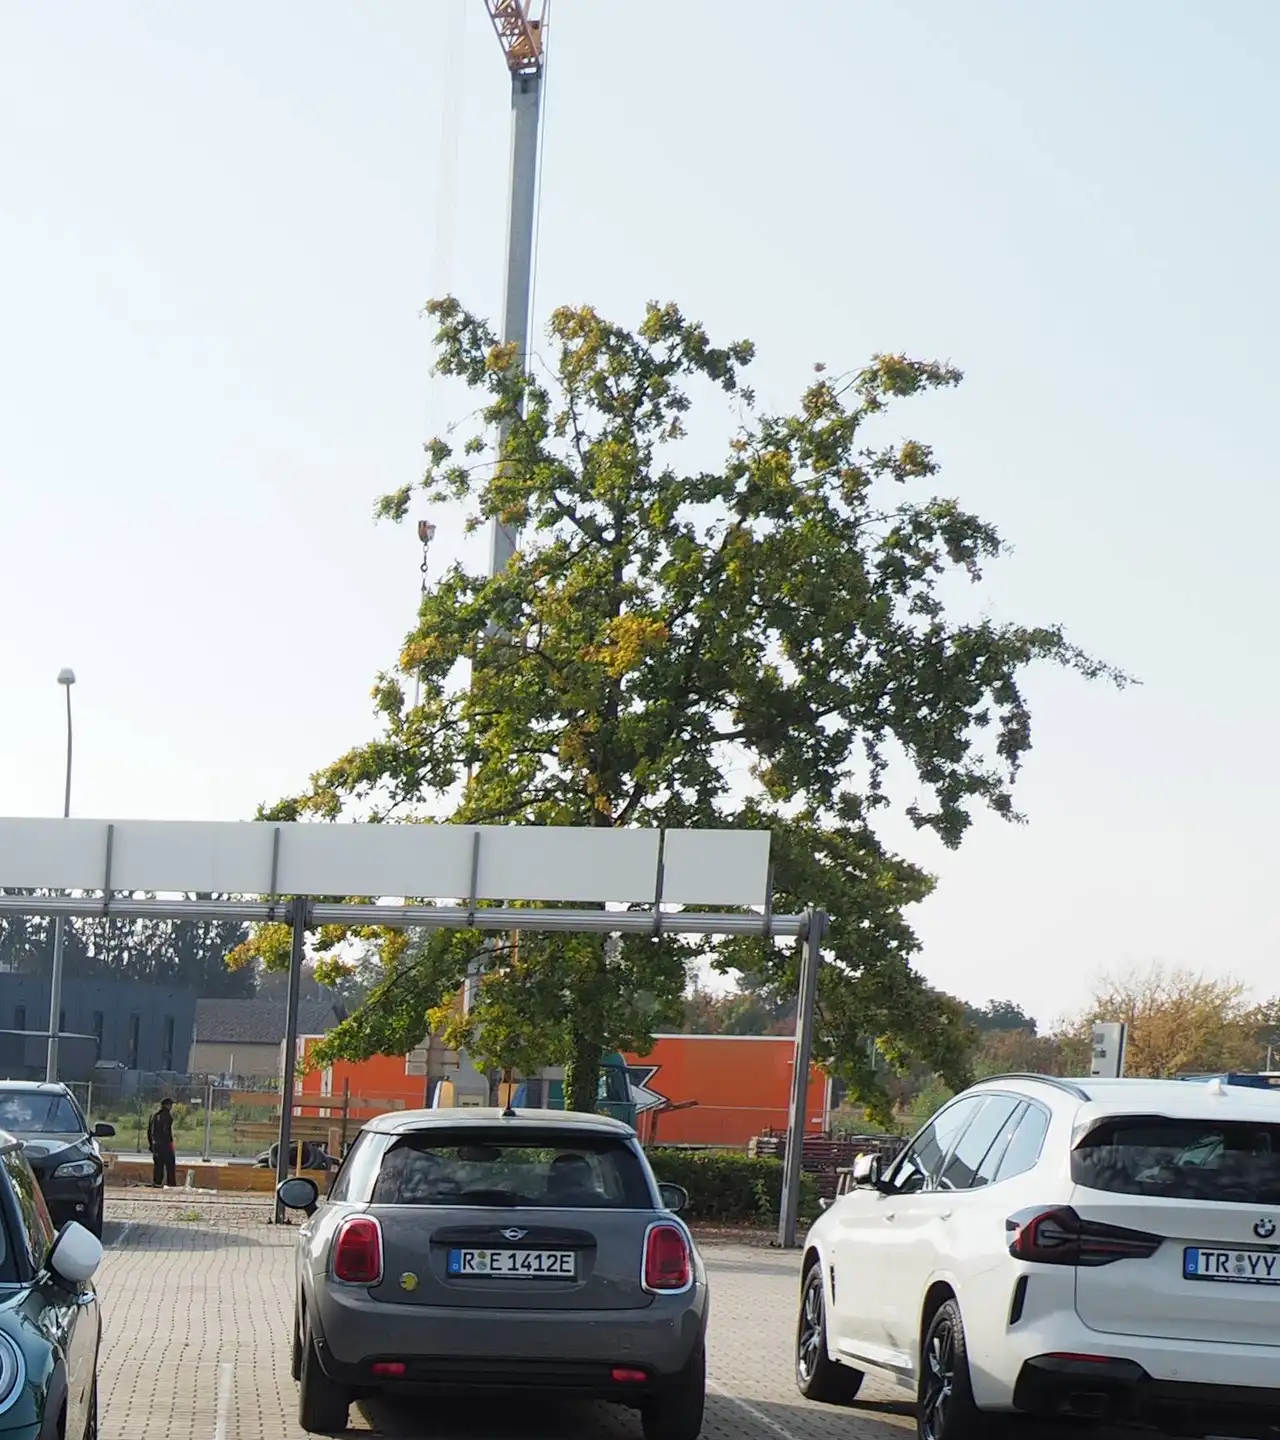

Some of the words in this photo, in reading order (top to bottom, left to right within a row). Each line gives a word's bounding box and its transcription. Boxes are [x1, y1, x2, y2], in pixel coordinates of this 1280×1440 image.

[462, 1252, 475, 1271] R
[507, 1252, 572, 1273] 1412E
[1201, 1251, 1229, 1273] TR
[1247, 1254, 1276, 1276] YY
